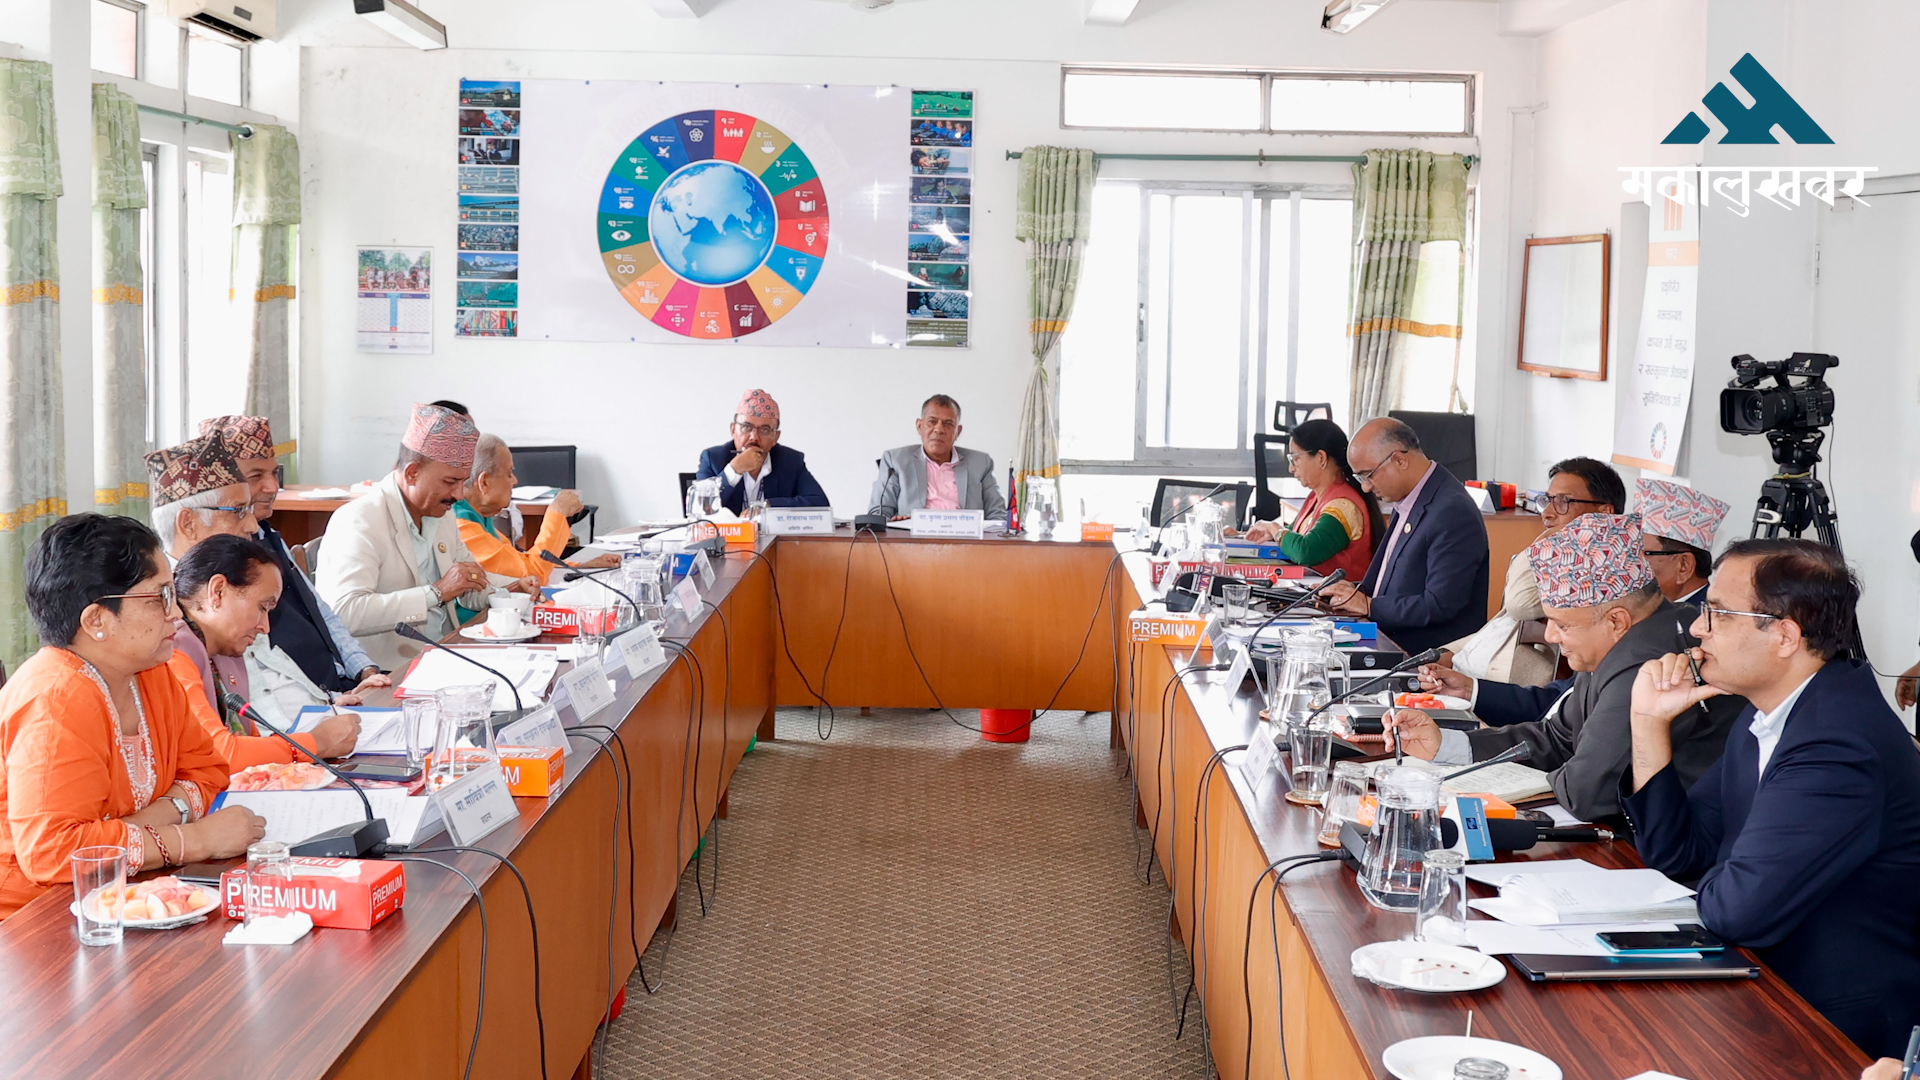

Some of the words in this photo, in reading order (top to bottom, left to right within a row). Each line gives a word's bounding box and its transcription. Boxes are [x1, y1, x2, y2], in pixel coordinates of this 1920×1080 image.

[1638, 364, 1644, 375] र
[1132, 621, 1196, 637] PREMIUM
[373, 874, 403, 906] PREMIUM
